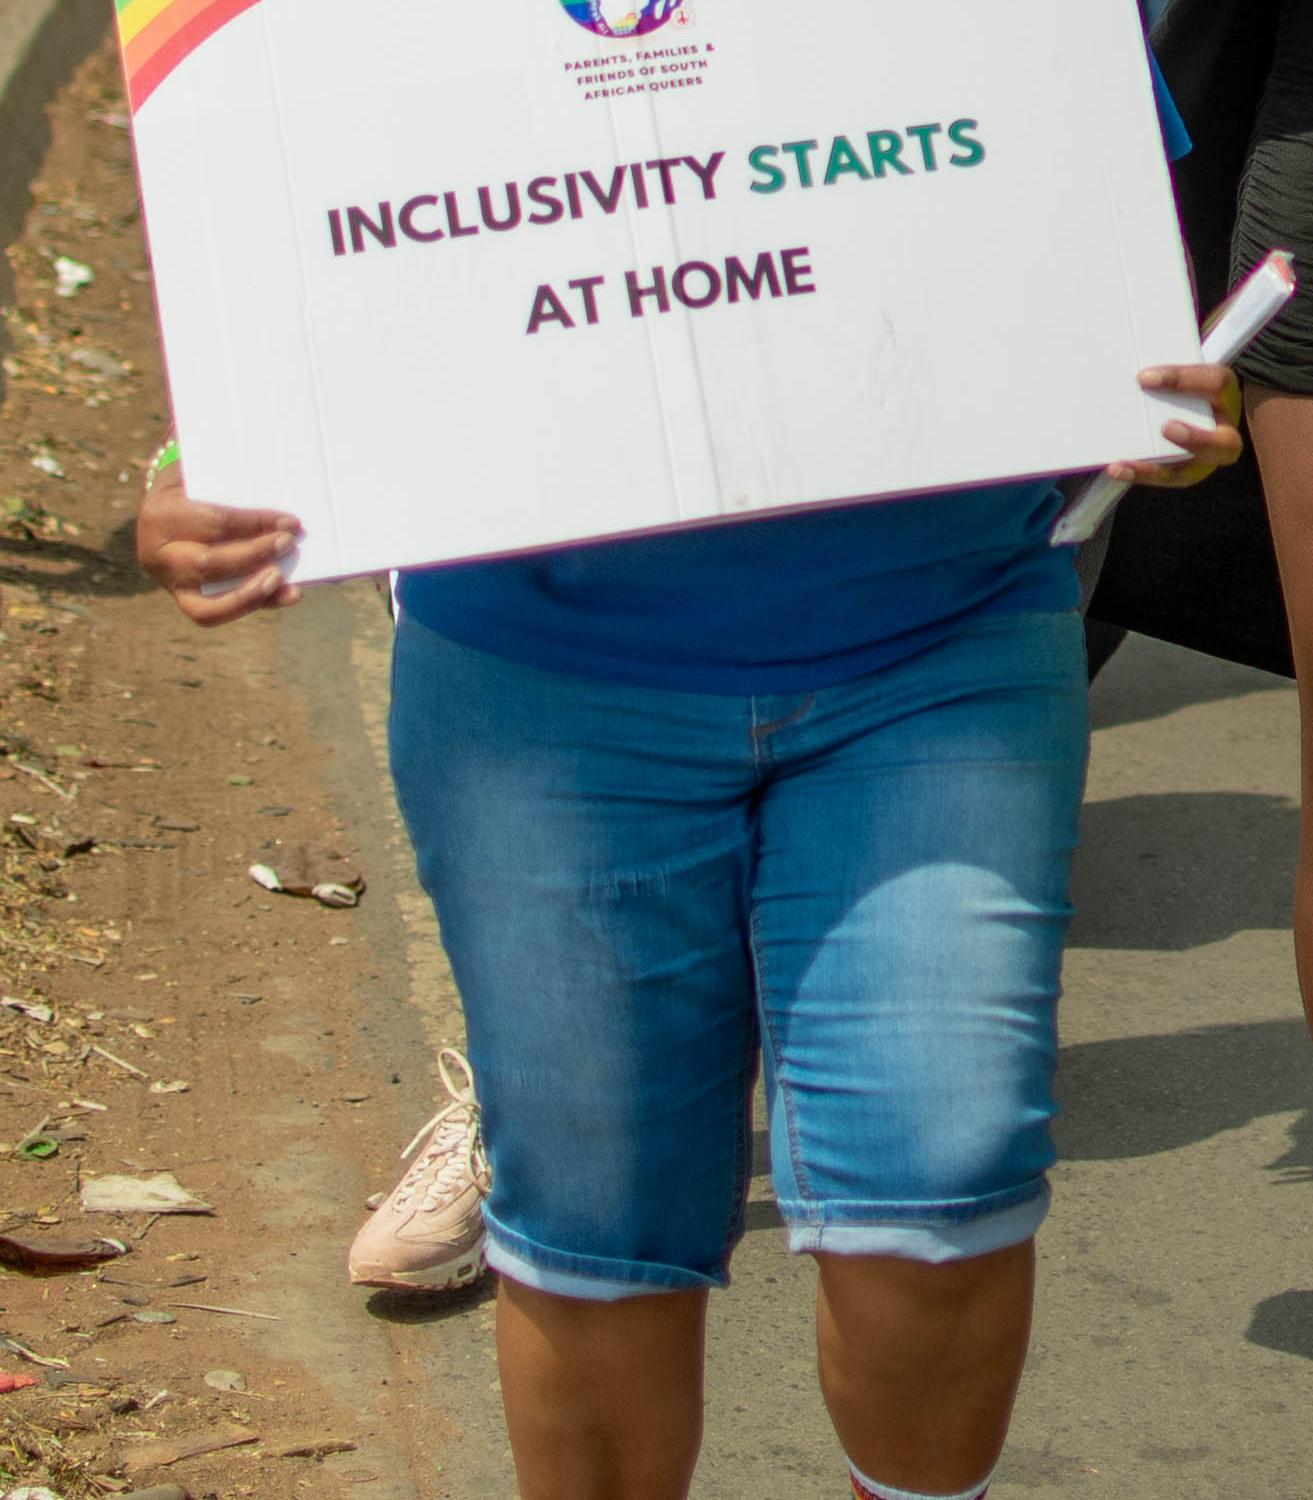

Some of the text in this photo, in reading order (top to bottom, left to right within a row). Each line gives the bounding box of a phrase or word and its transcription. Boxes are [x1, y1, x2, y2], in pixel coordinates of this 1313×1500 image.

[564, 43, 715, 71] PARENTS, FAMILIES &
[577, 59, 708, 85] FRIENDS OF SOUTH
[584, 75, 703, 100] AFRICAN QUEERS
[327, 118, 985, 257] INCLUSIVITY STARTS
[525, 246, 817, 335] AT HOME
